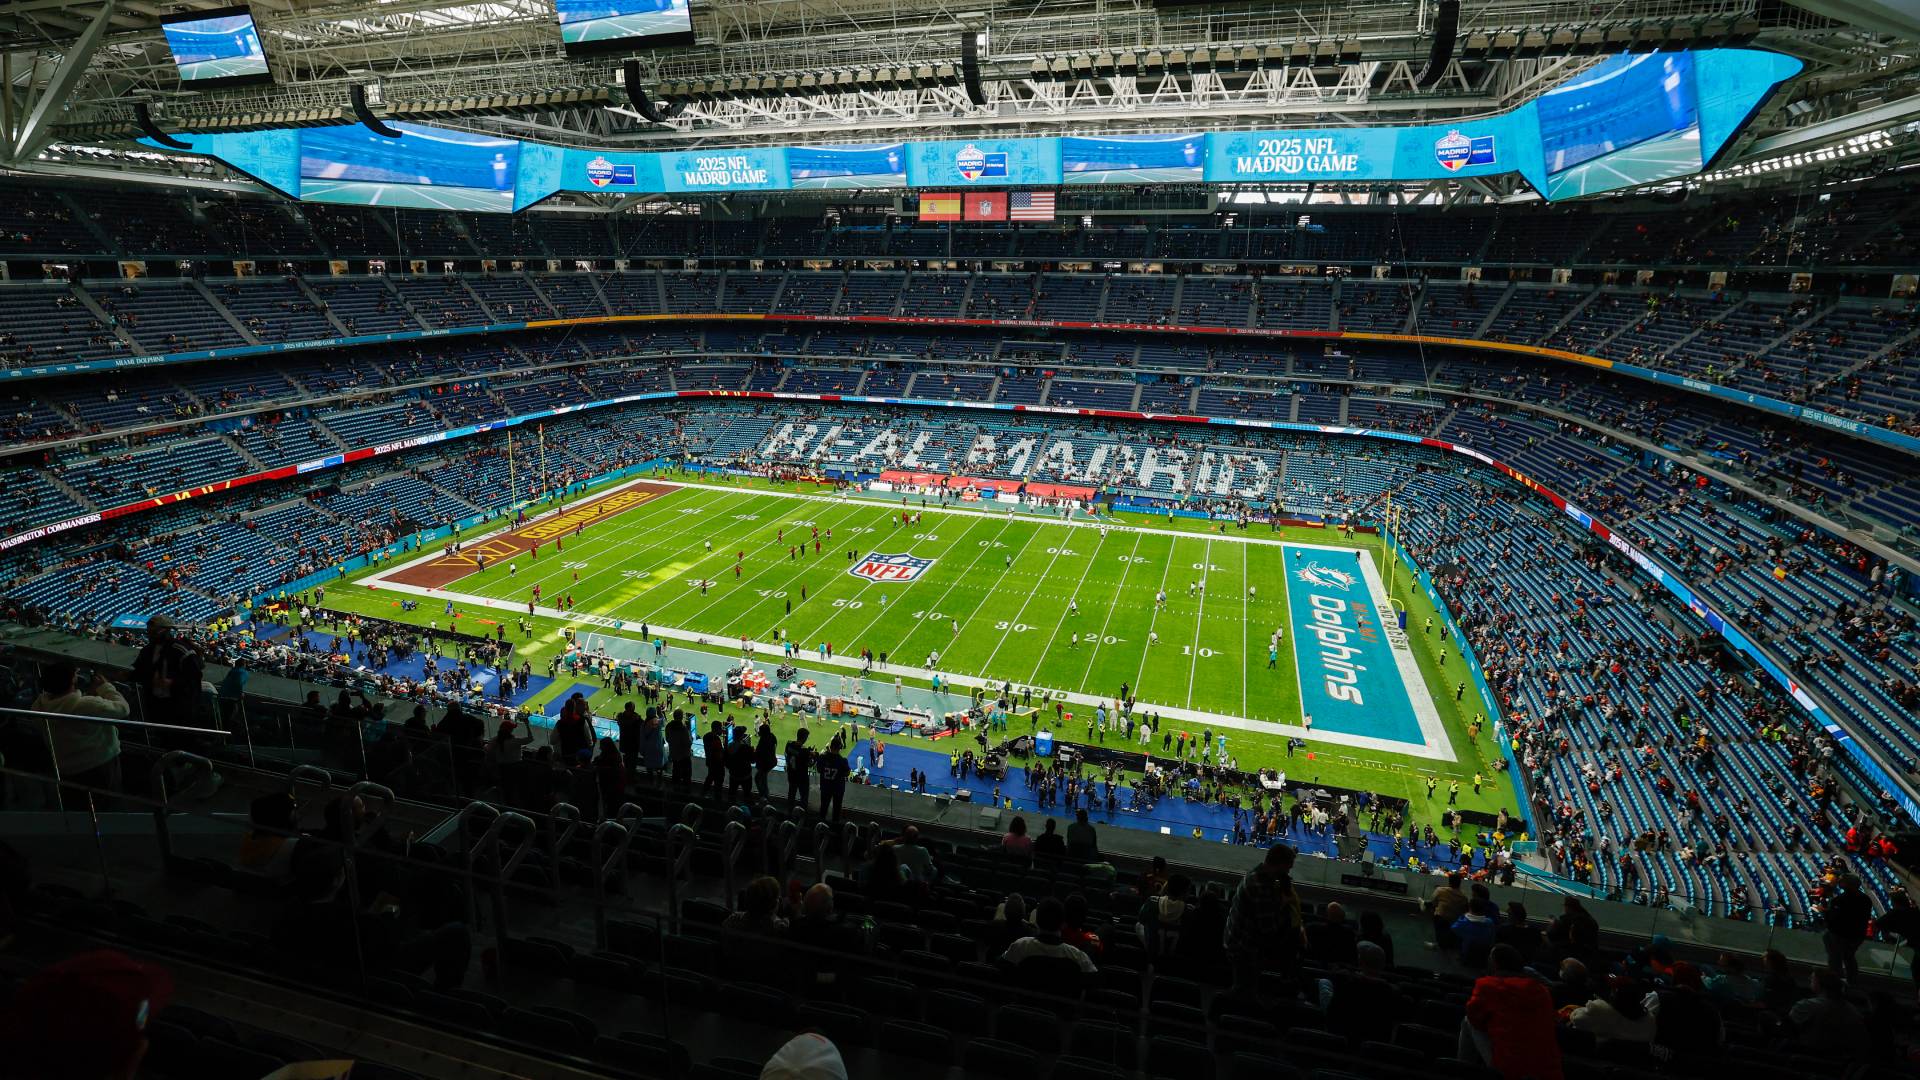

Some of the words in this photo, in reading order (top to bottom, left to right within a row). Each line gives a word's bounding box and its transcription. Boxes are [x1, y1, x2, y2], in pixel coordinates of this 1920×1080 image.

[1259, 139, 1301, 156] 2025
[1305, 138, 1337, 155] NFL
[696, 157, 726, 171] 2025
[728, 156, 750, 170] NFL
[1237, 156, 1303, 173] MADRID
[1307, 154, 1358, 172] GAME
[686, 172, 731, 186] MADRID
[732, 169, 767, 184] GAME
[115, 359, 135, 367] MIAMI
[136, 356, 165, 364] DOLPHINS
[374, 446, 391, 455] 2025
[391, 442, 404, 451] NFL
[404, 437, 428, 448] MADRID
[428, 433, 446, 443] GAME
[761, 423, 940, 470] REAL
[960, 434, 1278, 499] MADRID
[520, 491, 650, 539] COMMANDERS
[0, 529, 46, 550] WASHINGTON
[46, 513, 102, 534] COMMANDERS
[626, 570, 651, 579] 20
[857, 562, 912, 579] NFL
[688, 579, 717, 589] 30
[758, 589, 787, 599] 40
[832, 599, 863, 609] 50
[912, 611, 943, 621] 40
[995, 622, 1028, 632] 30
[1084, 633, 1118, 645] 20
[1383, 621, 1408, 650] RACISM
[1181, 646, 1213, 658] 10
[1305, 594, 1367, 705] Dolphins
[824, 768, 838, 779] 27
